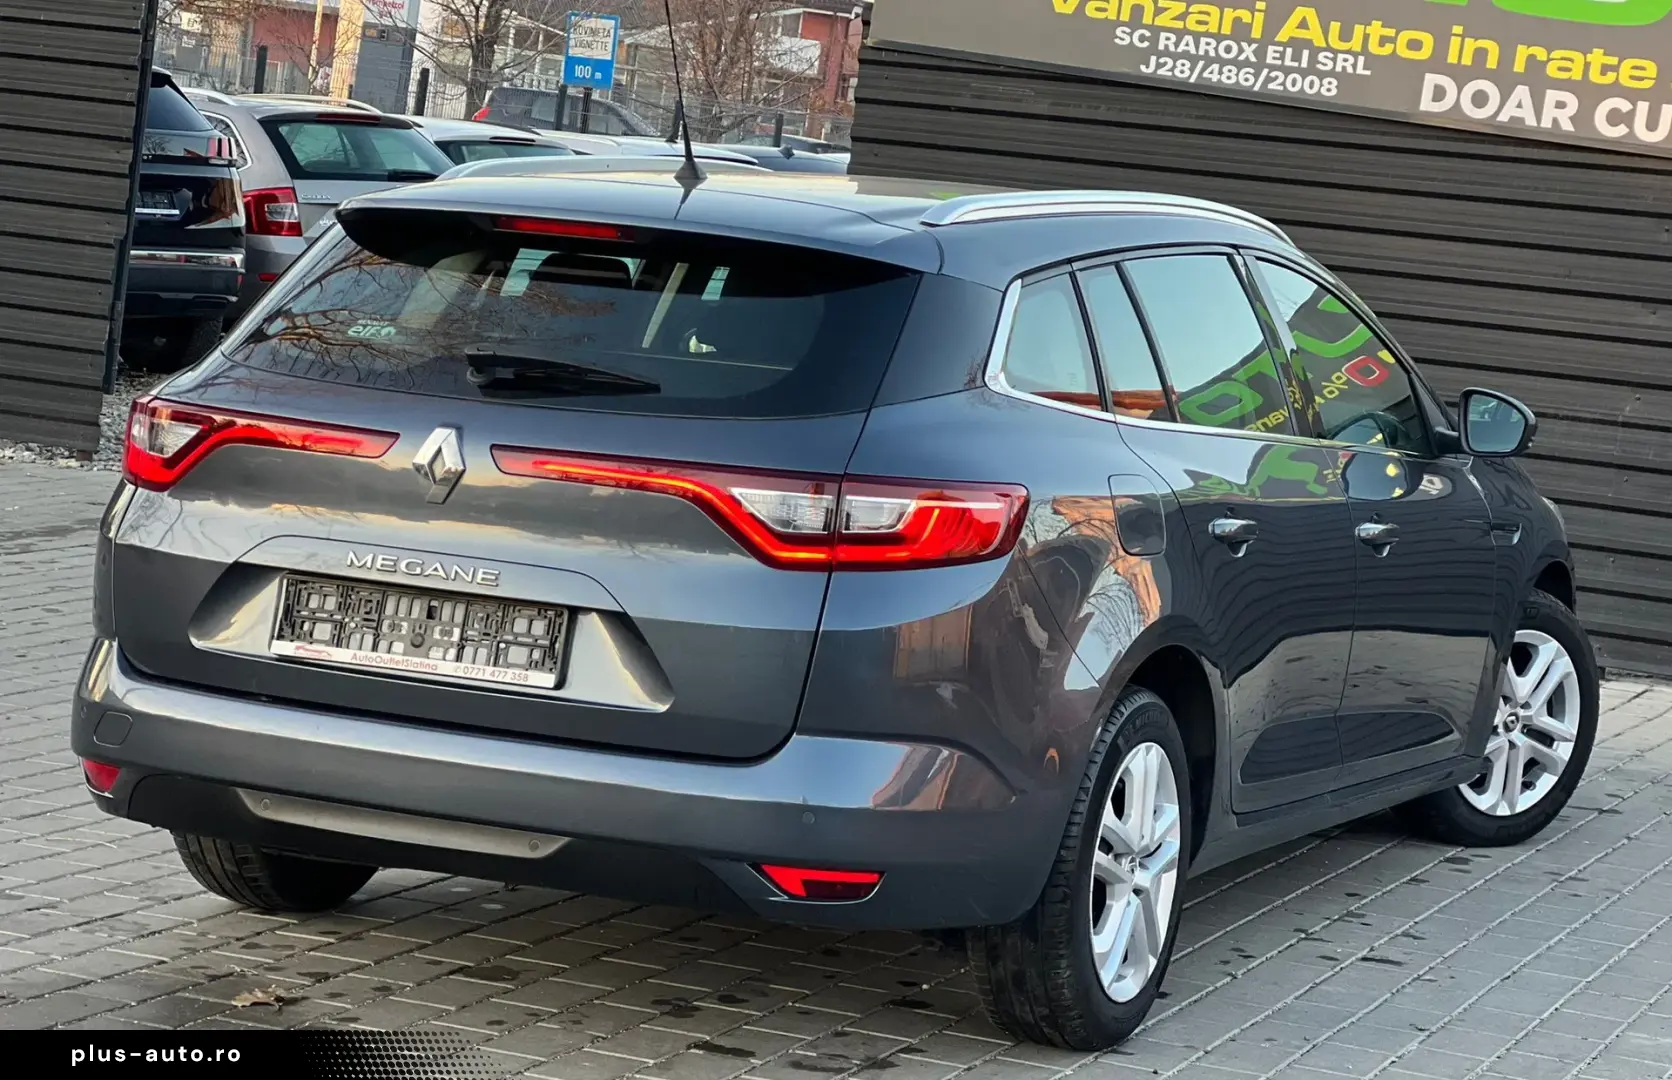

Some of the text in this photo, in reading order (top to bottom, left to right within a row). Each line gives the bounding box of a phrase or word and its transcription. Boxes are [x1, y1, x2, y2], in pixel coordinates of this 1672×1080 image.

[1114, 26, 1371, 75] SC RAROX ELI SRL
[1275, 6, 1434, 60] Auto
[1446, 25, 1500, 70] in
[1513, 44, 1658, 89] rate
[574, 65, 592, 78] 100
[1139, 55, 1338, 97] J28/486/2008
[1419, 72, 1672, 143] DOAR CU
[346, 550, 500, 587] MEGANE
[350, 652, 438, 672] AutoOutletSlatina
[462, 666, 529, 683] 0771 477 358
